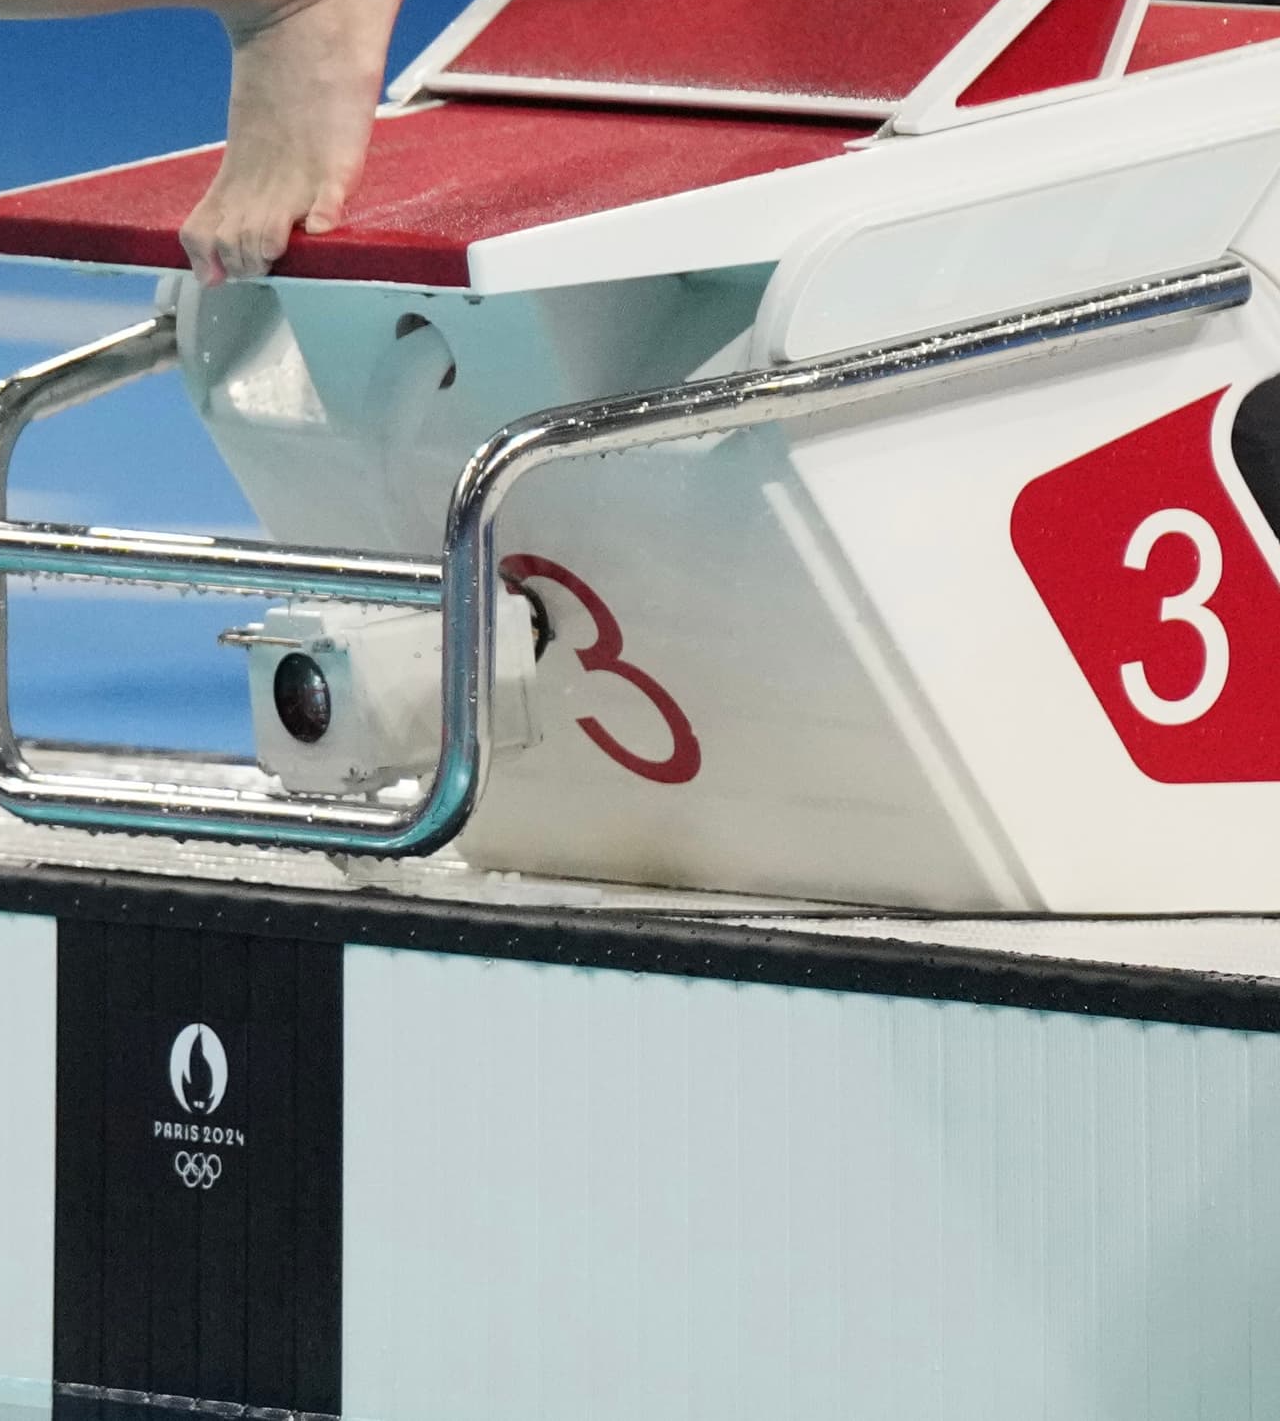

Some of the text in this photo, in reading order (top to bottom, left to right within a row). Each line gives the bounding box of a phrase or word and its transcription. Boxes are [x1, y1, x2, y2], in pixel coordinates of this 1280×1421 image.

[498, 553, 702, 783] 3
[1120, 508, 1230, 726] 3
[154, 1121, 245, 1146] PARIS 2024
